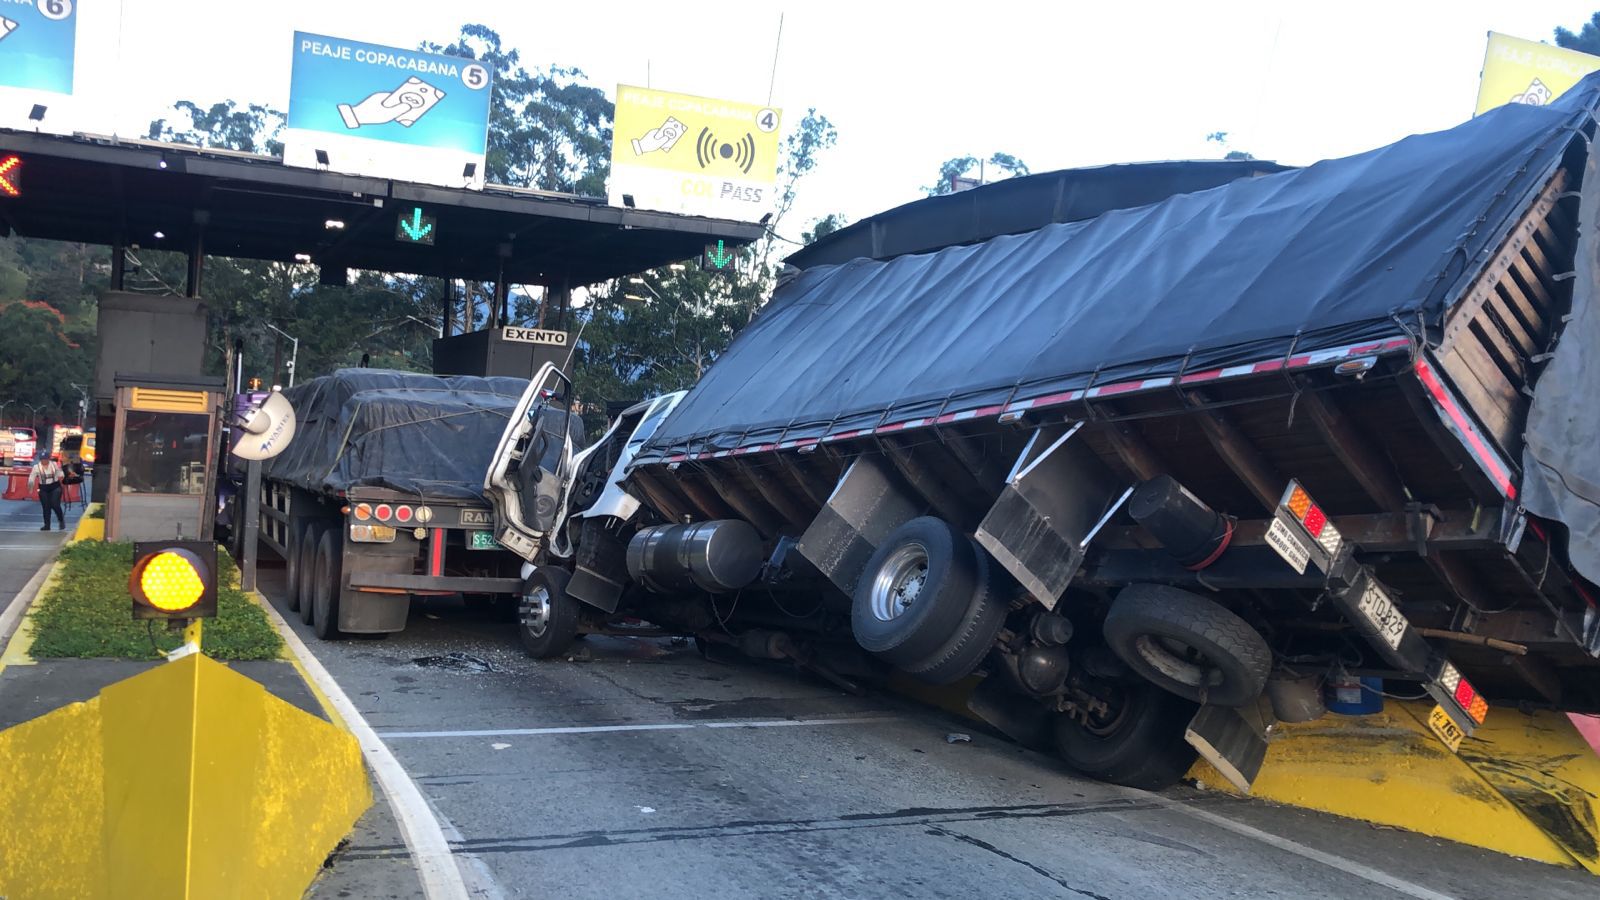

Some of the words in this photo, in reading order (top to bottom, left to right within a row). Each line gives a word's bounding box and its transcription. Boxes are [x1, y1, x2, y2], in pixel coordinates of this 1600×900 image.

[47, 0, 64, 15] 6
[302, 40, 351, 60] PEAJE
[355, 49, 458, 78] COPACABANA
[468, 68, 482, 85] 5
[761, 112, 774, 129] 4
[719, 181, 763, 203] PASS
[505, 328, 565, 344] EXENTO
[1442, 719, 1462, 742] 767
